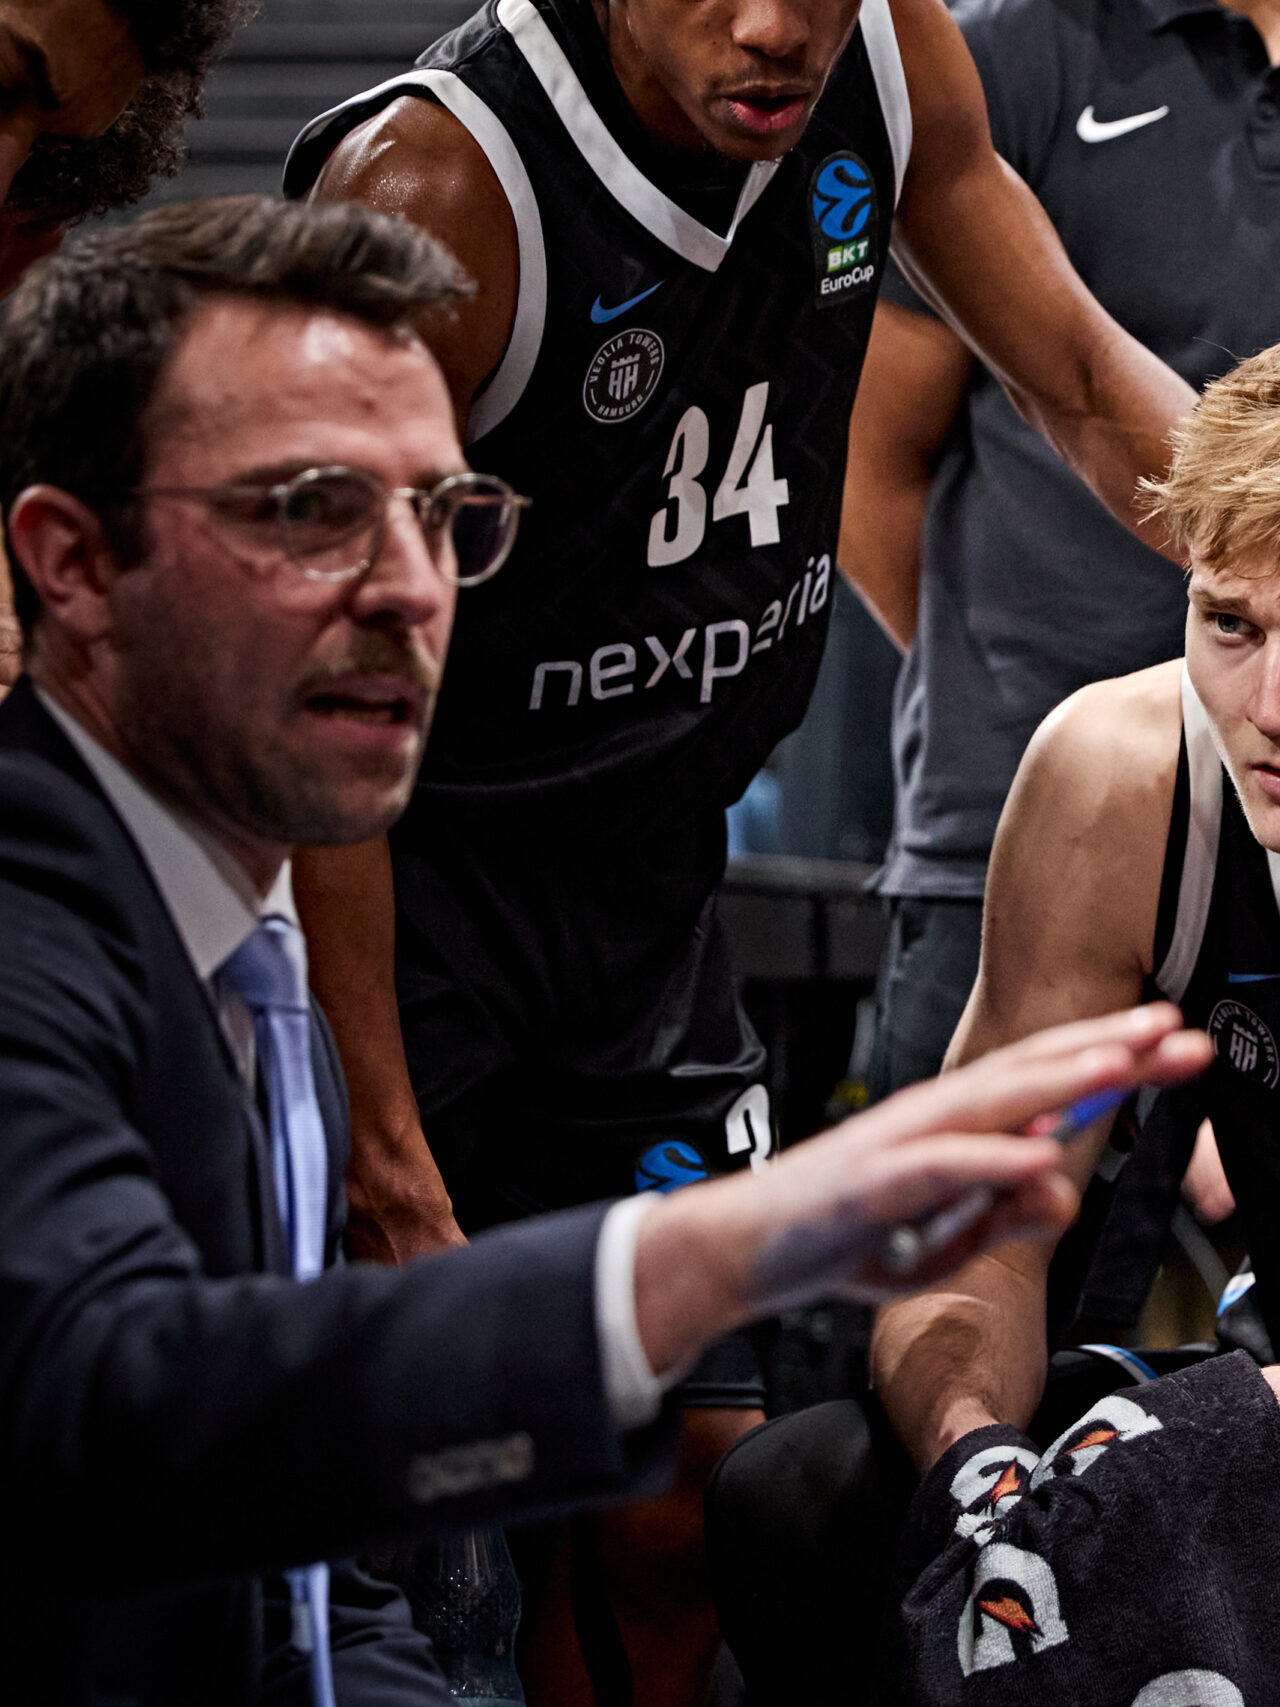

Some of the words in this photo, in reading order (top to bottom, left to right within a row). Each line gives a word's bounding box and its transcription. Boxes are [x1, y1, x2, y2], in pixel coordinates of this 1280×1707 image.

[827, 240, 869, 269] BKT
[820, 264, 875, 295] EuroCup
[588, 338, 624, 384] VEOLIA
[628, 333, 661, 366] TOWERS
[597, 393, 644, 417] HAMBURG
[647, 381, 790, 568] 34
[528, 553, 831, 710] nexperia
